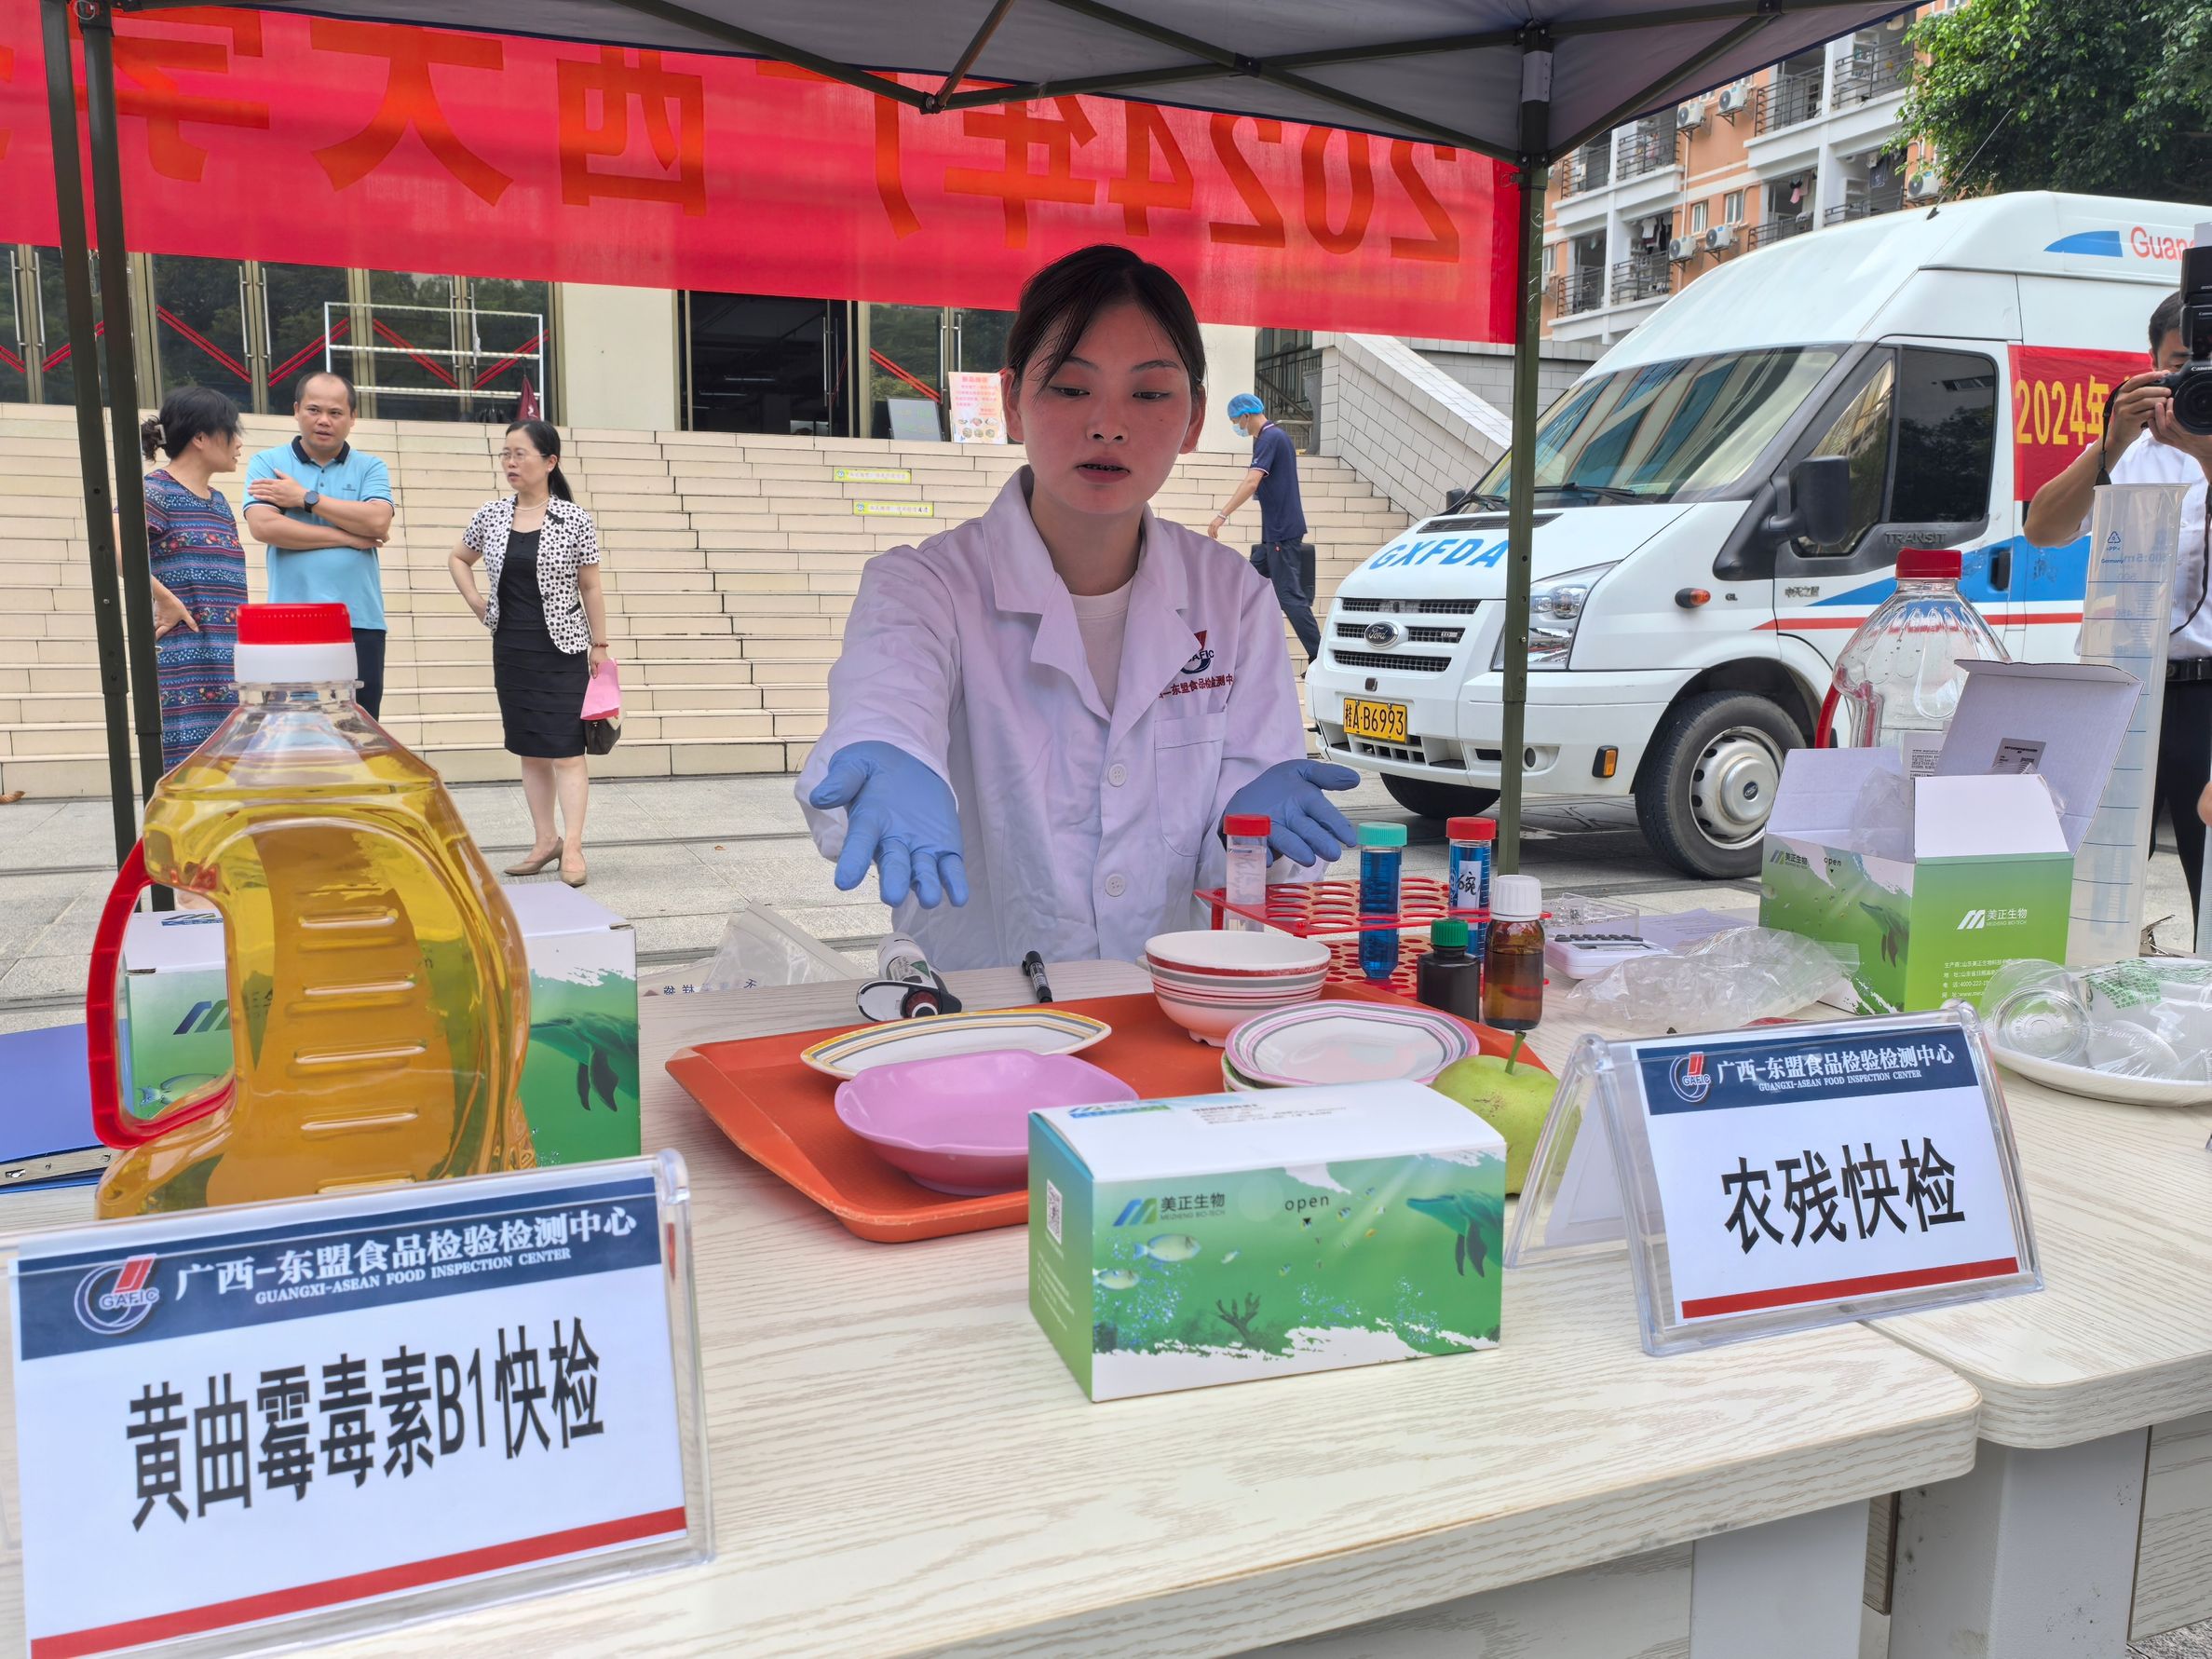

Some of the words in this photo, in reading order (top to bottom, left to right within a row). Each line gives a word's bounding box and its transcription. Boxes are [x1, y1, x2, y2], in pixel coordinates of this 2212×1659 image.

[2130, 226, 2196, 260] Guan
[1885, 533, 1947, 544] TRANSIT
[1368, 538, 1510, 570] GXFDA
[1369, 625, 1388, 640] Ford
[1187, 649, 1215, 663] AFIC
[1785, 851, 1808, 865] 美正生物
[1824, 856, 1841, 867] open
[1987, 907, 2028, 920] 美正生物
[1758, 1081, 1822, 1092] GUANGXI-ASEAN
[1824, 1077, 1845, 1085] FOOD
[1847, 1072, 1892, 1084] INSPECTION
[1893, 1069, 1922, 1080] CENTER
[1160, 1192, 1226, 1212] 美正生物
[1284, 1194, 1329, 1214] open
[1720, 1135, 1966, 1255] 农残快检
[255, 1275, 380, 1304] GUANGXI-ASEAN
[386, 1269, 427, 1287] FOOD
[430, 1255, 514, 1282] INSPECTION
[519, 1246, 571, 1266] CENTER
[99, 1286, 159, 1311] GAFIC
[125, 1316, 605, 1533] 黄曲霉毒素B1快检
